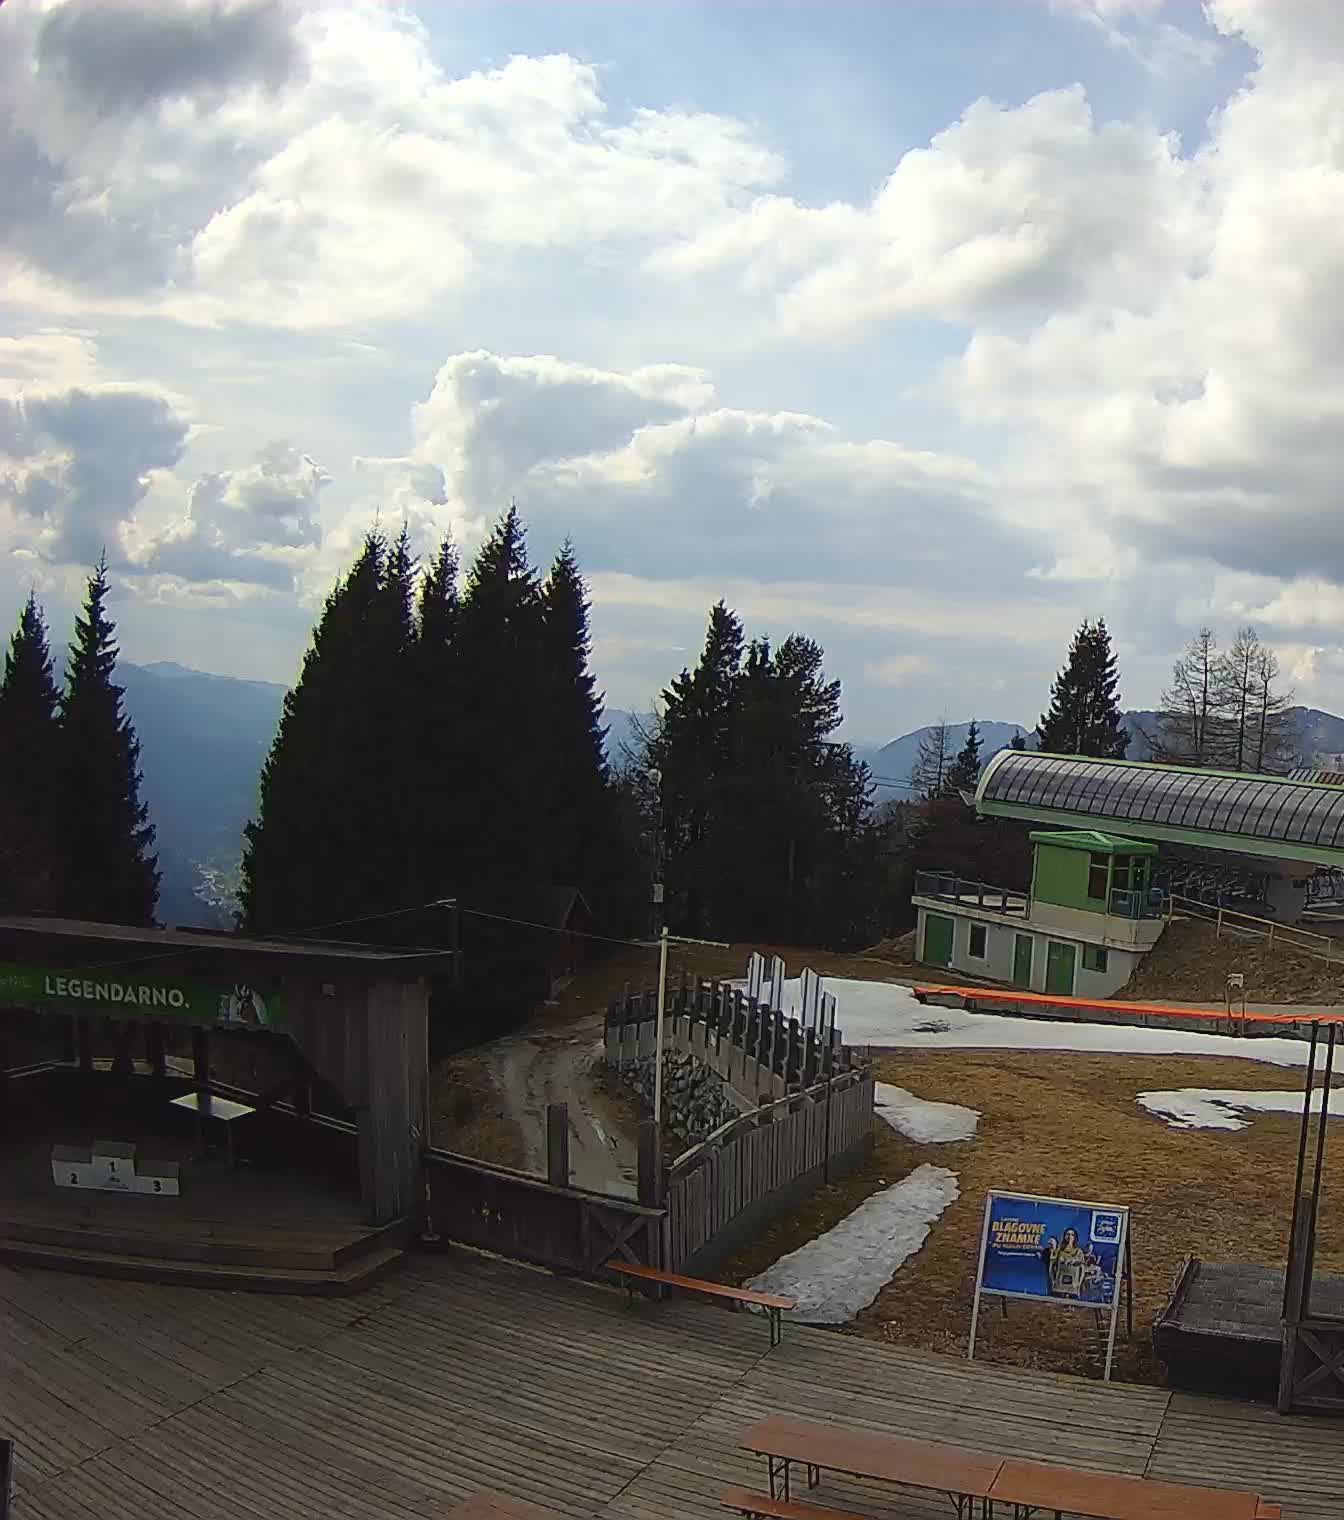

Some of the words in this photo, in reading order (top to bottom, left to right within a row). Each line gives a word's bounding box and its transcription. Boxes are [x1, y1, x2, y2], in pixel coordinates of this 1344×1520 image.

[44, 975, 190, 1009] LEGENDARNO.
[107, 1161, 116, 1173] 1
[70, 1172, 78, 1185] 2
[152, 1180, 162, 1192] 3
